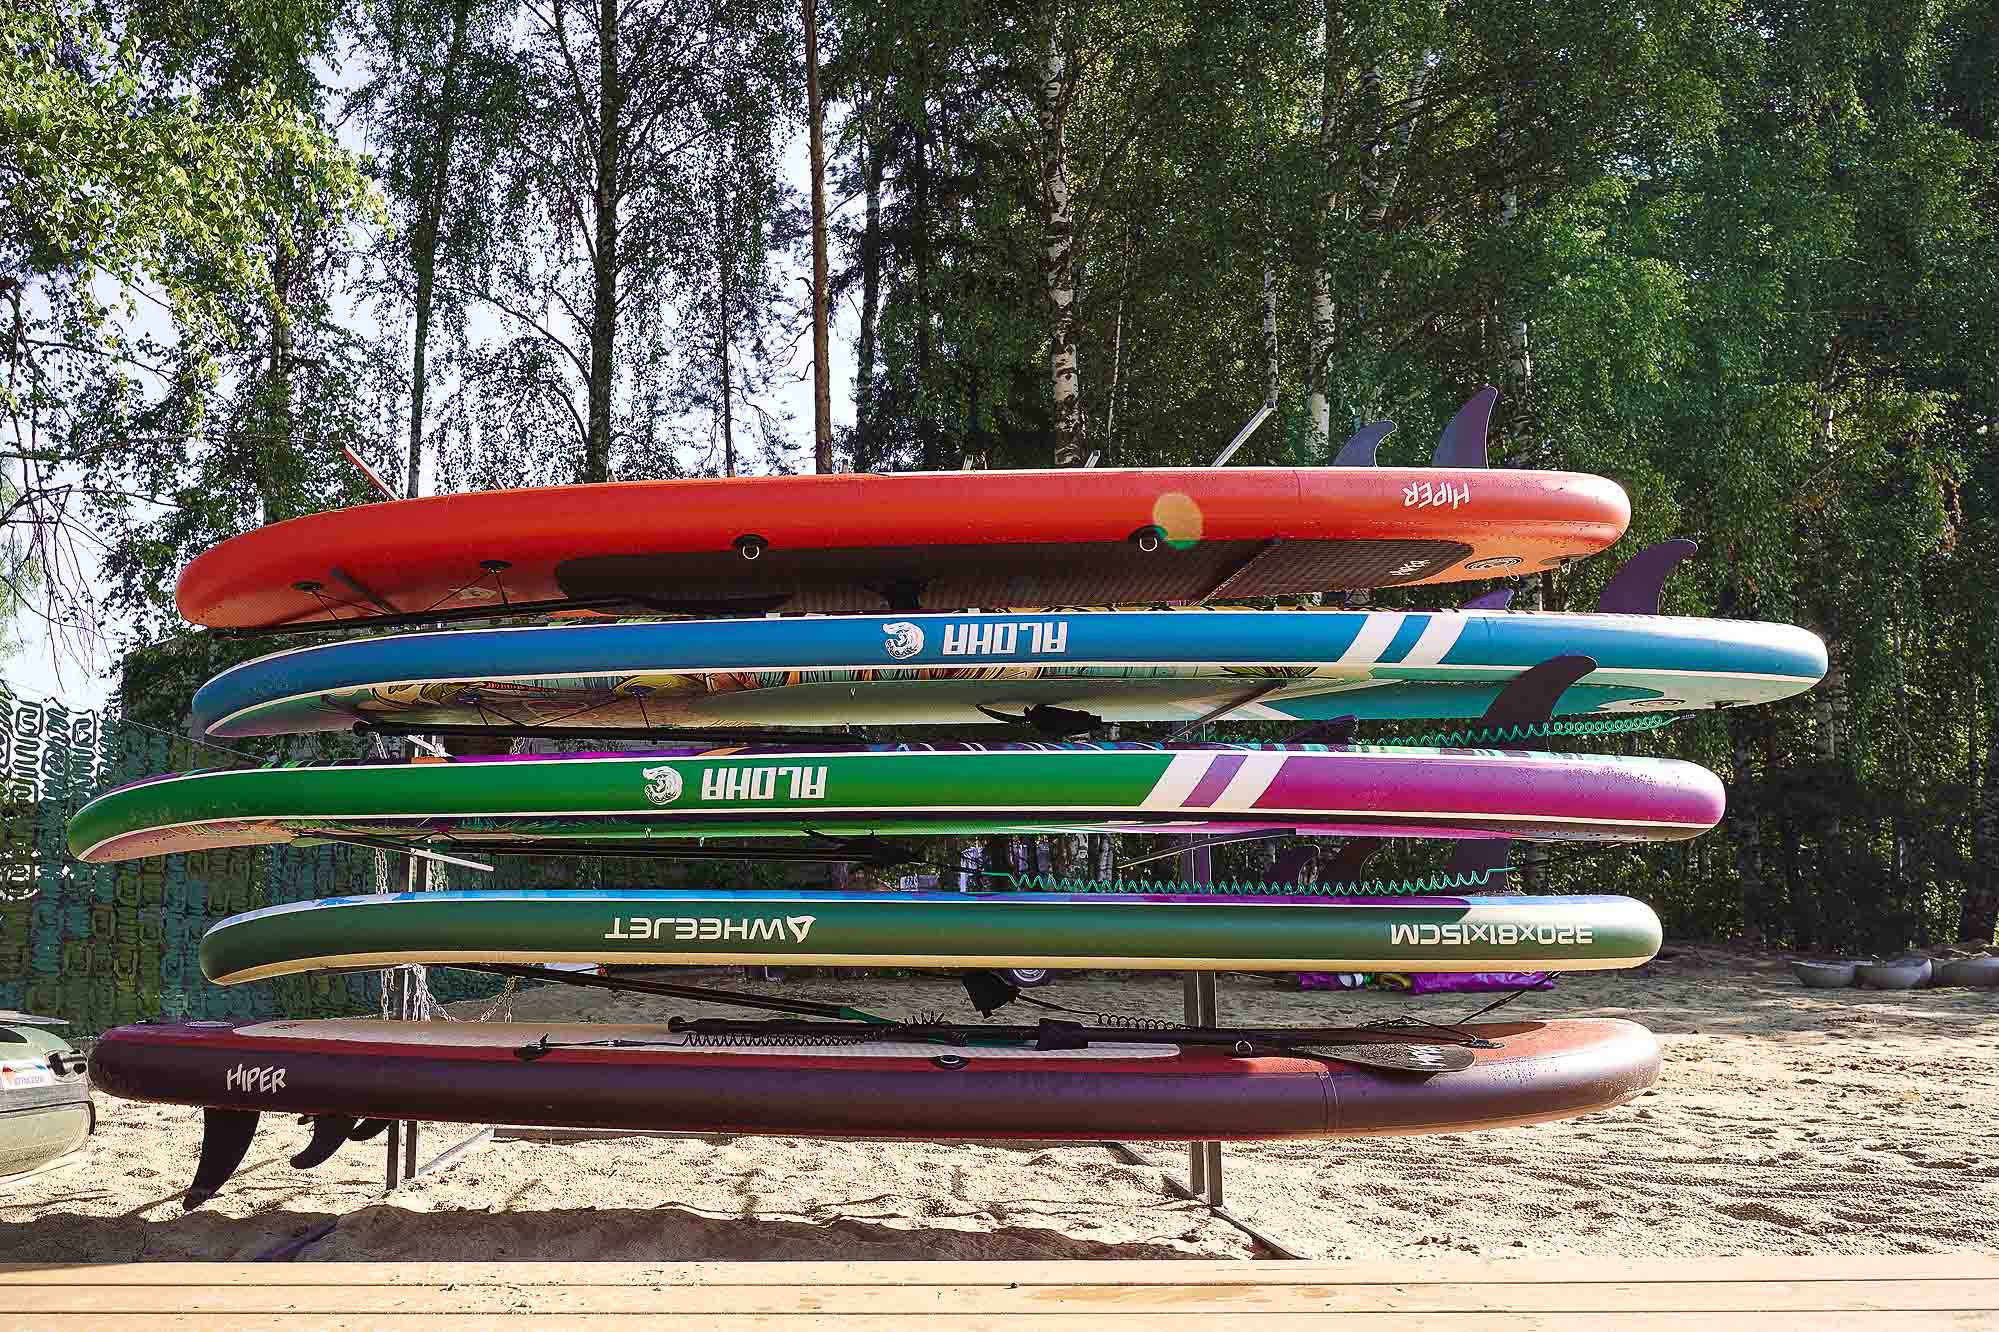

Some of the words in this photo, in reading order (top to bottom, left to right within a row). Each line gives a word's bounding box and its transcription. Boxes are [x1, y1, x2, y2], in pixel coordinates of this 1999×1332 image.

[1401, 482, 1470, 510] HIPER
[942, 622, 1068, 655] ALOHA
[701, 767, 828, 801] ALOHA
[604, 917, 787, 941] WHEEJET
[226, 1063, 287, 1094] HIPER
